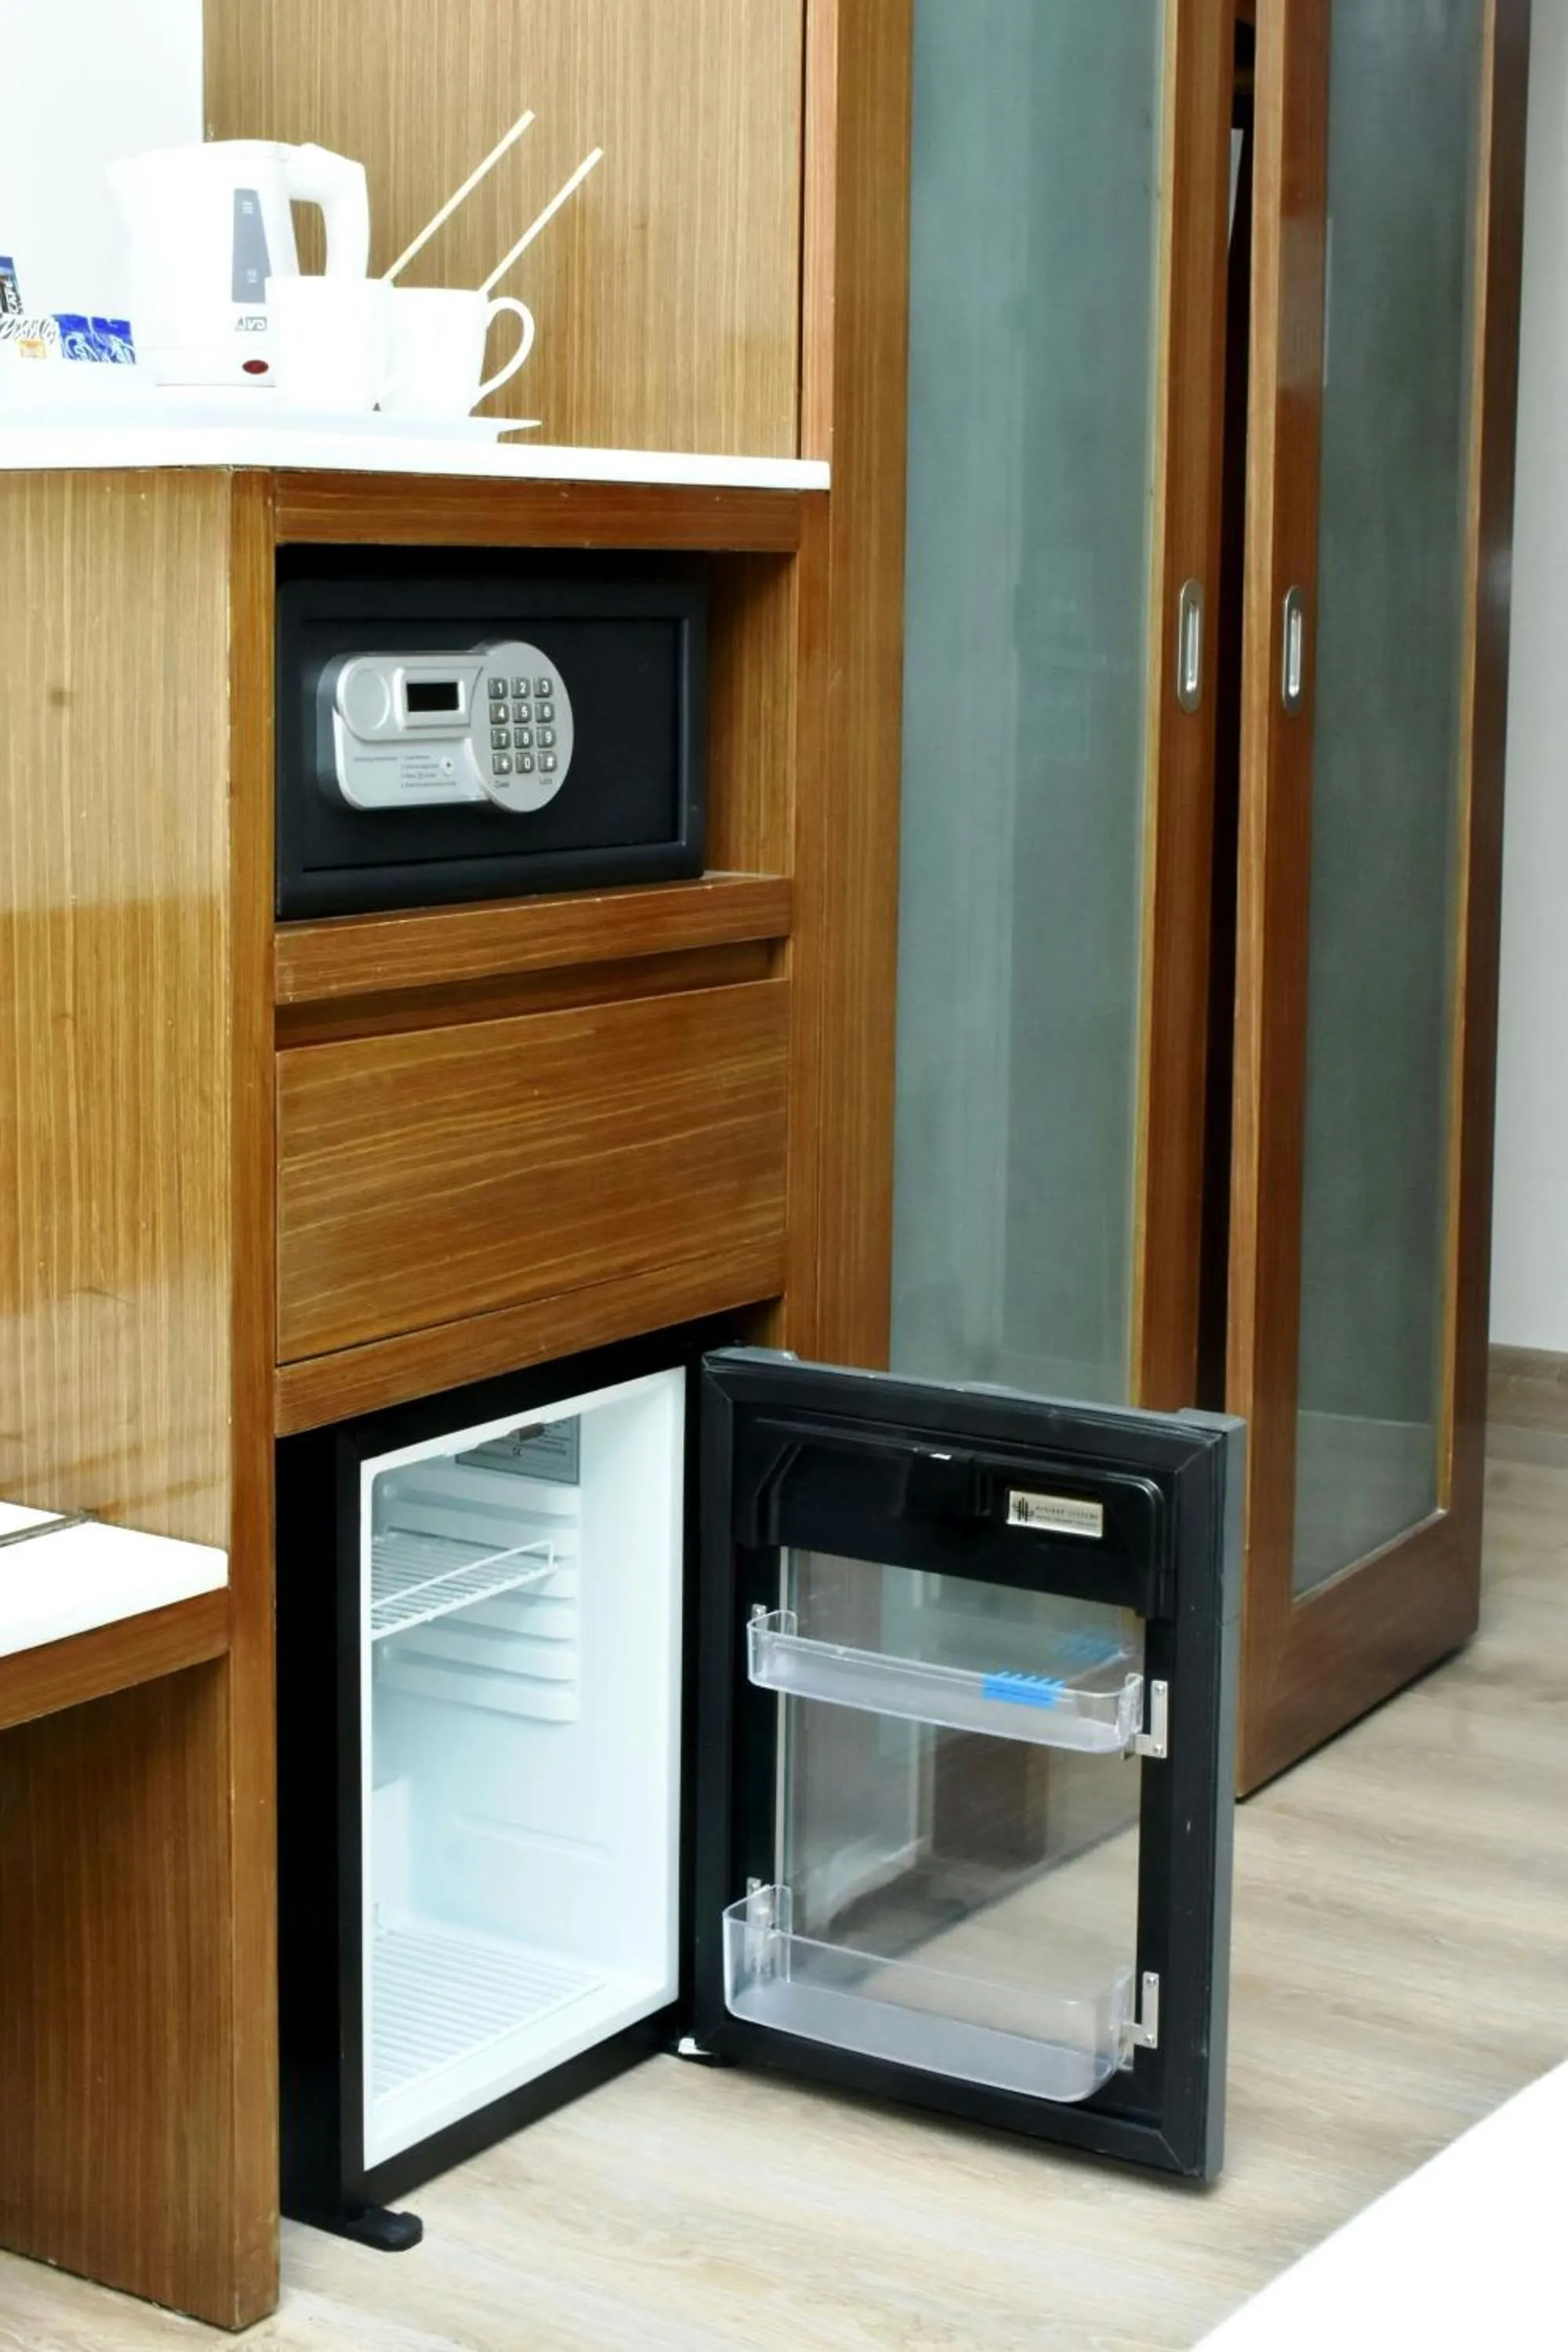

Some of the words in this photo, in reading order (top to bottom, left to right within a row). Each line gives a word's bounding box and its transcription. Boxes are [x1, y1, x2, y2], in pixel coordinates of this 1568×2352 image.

[498, 682, 503, 694] 1
[520, 681, 526, 694] 2
[542, 680, 549, 693] 3
[498, 706, 505, 718] 4
[521, 706, 528, 718] 5
[544, 706, 551, 718] 6
[500, 732, 507, 745] 7
[523, 731, 529, 745] 8
[545, 731, 552, 744] 9
[524, 757, 531, 769] 0
